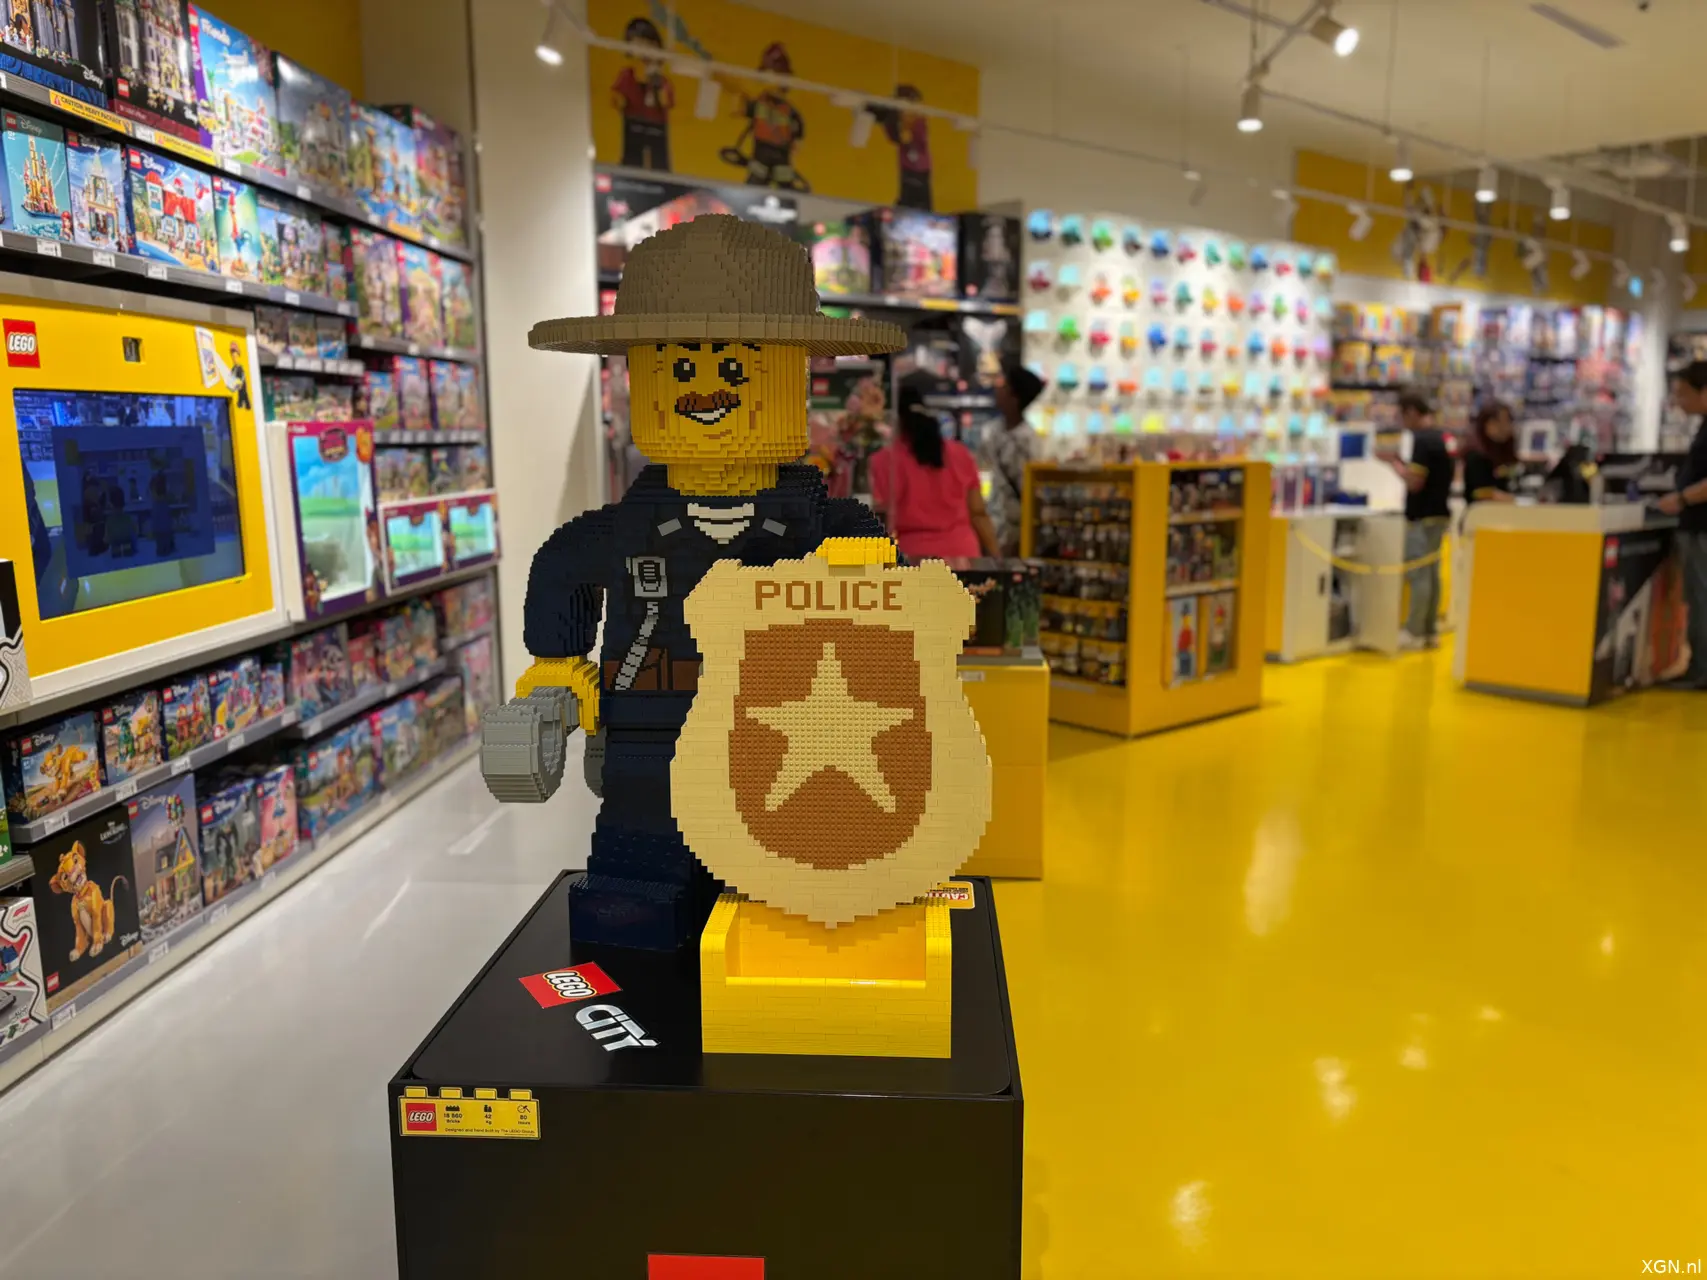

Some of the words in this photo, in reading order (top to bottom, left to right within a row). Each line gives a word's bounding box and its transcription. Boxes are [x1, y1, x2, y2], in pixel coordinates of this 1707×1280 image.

[8, 332, 36, 354] LEGO
[755, 580, 902, 610] POLICE
[543, 970, 597, 999] LEGO
[575, 1004, 659, 1052] CITY
[408, 1111, 434, 1123] LEGO
